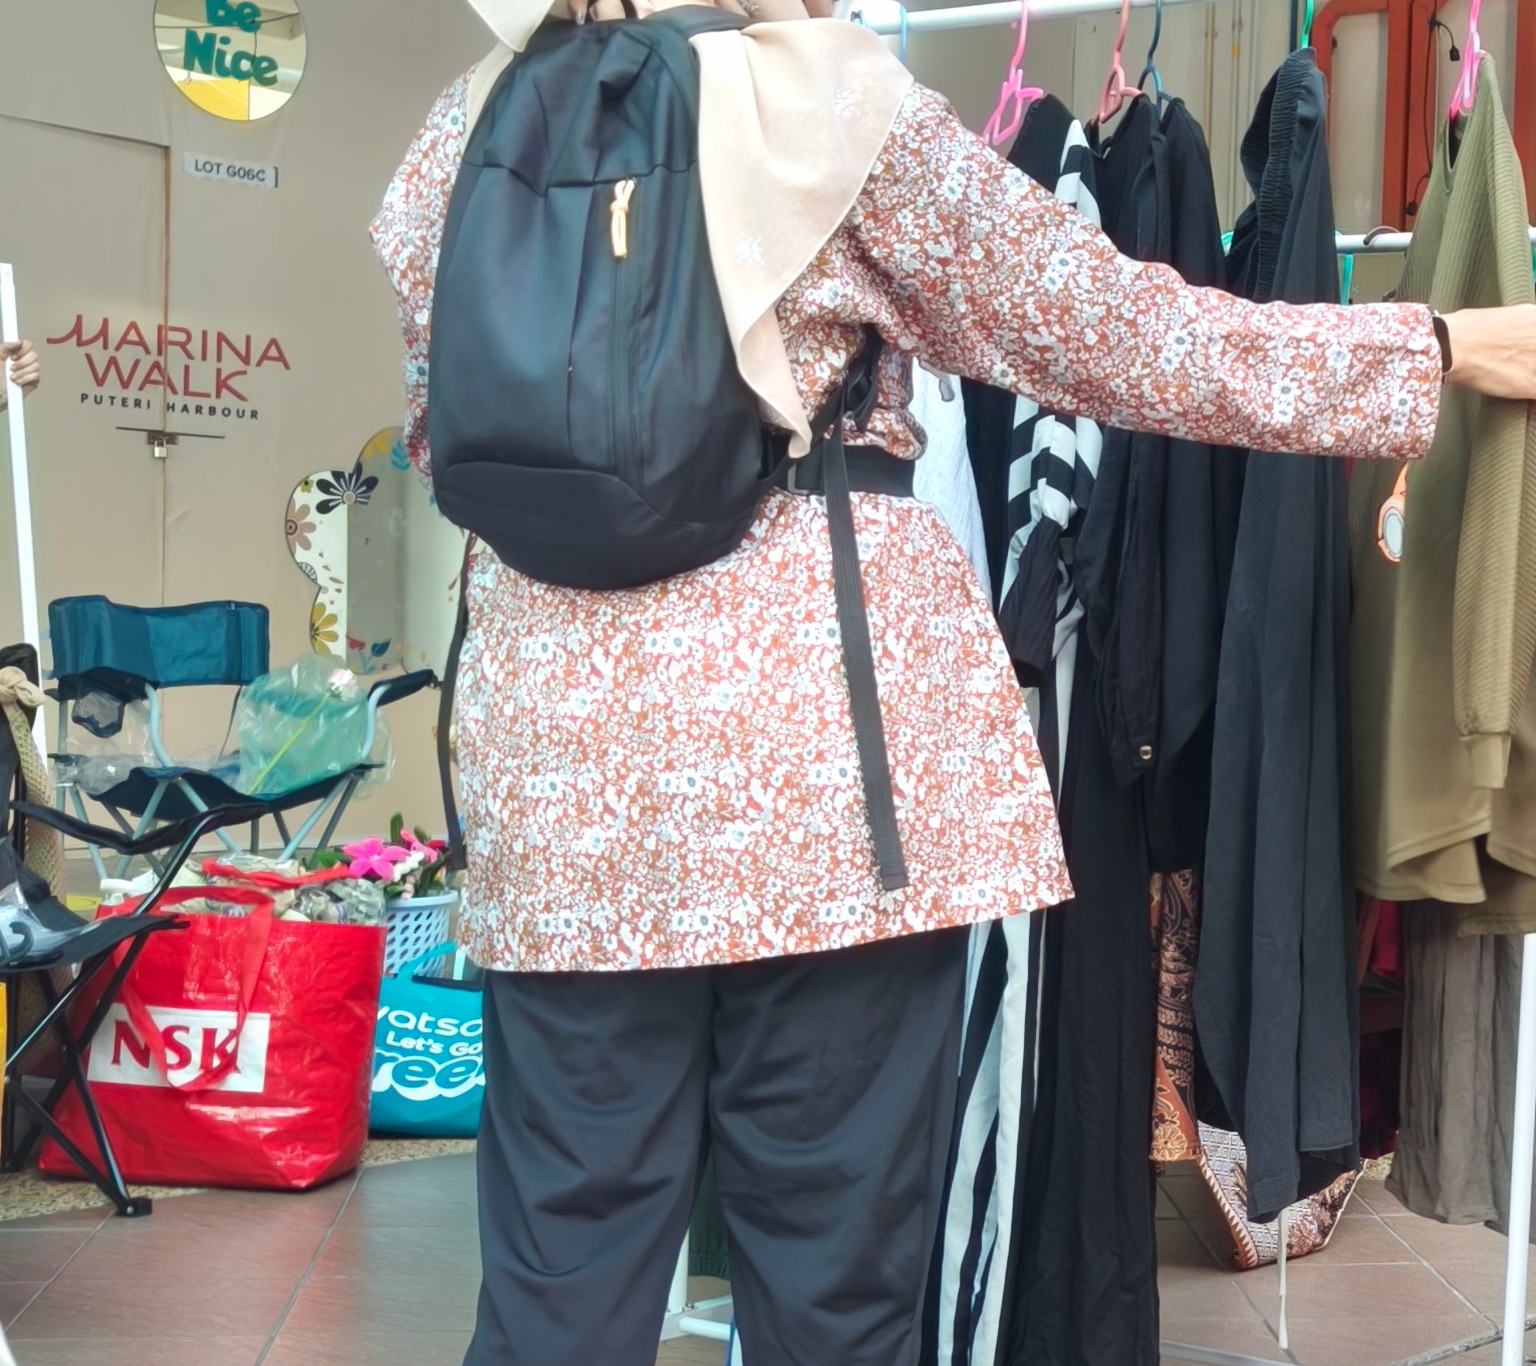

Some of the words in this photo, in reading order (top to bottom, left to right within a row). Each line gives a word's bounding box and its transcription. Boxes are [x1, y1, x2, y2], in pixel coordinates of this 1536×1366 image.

[183, 28, 279, 87] Nice
[194, 158, 223, 175] LOT
[226, 164, 266, 182] G06C
[46, 314, 291, 371] MARINA
[84, 352, 249, 402] WALK
[80, 392, 151, 410] PUTERI
[166, 402, 259, 420] HARBOUR
[377, 1005, 483, 1037] atso
[386, 1030, 445, 1054] Let's
[111, 1018, 242, 1074] NSK
[372, 1047, 484, 1096] ree
